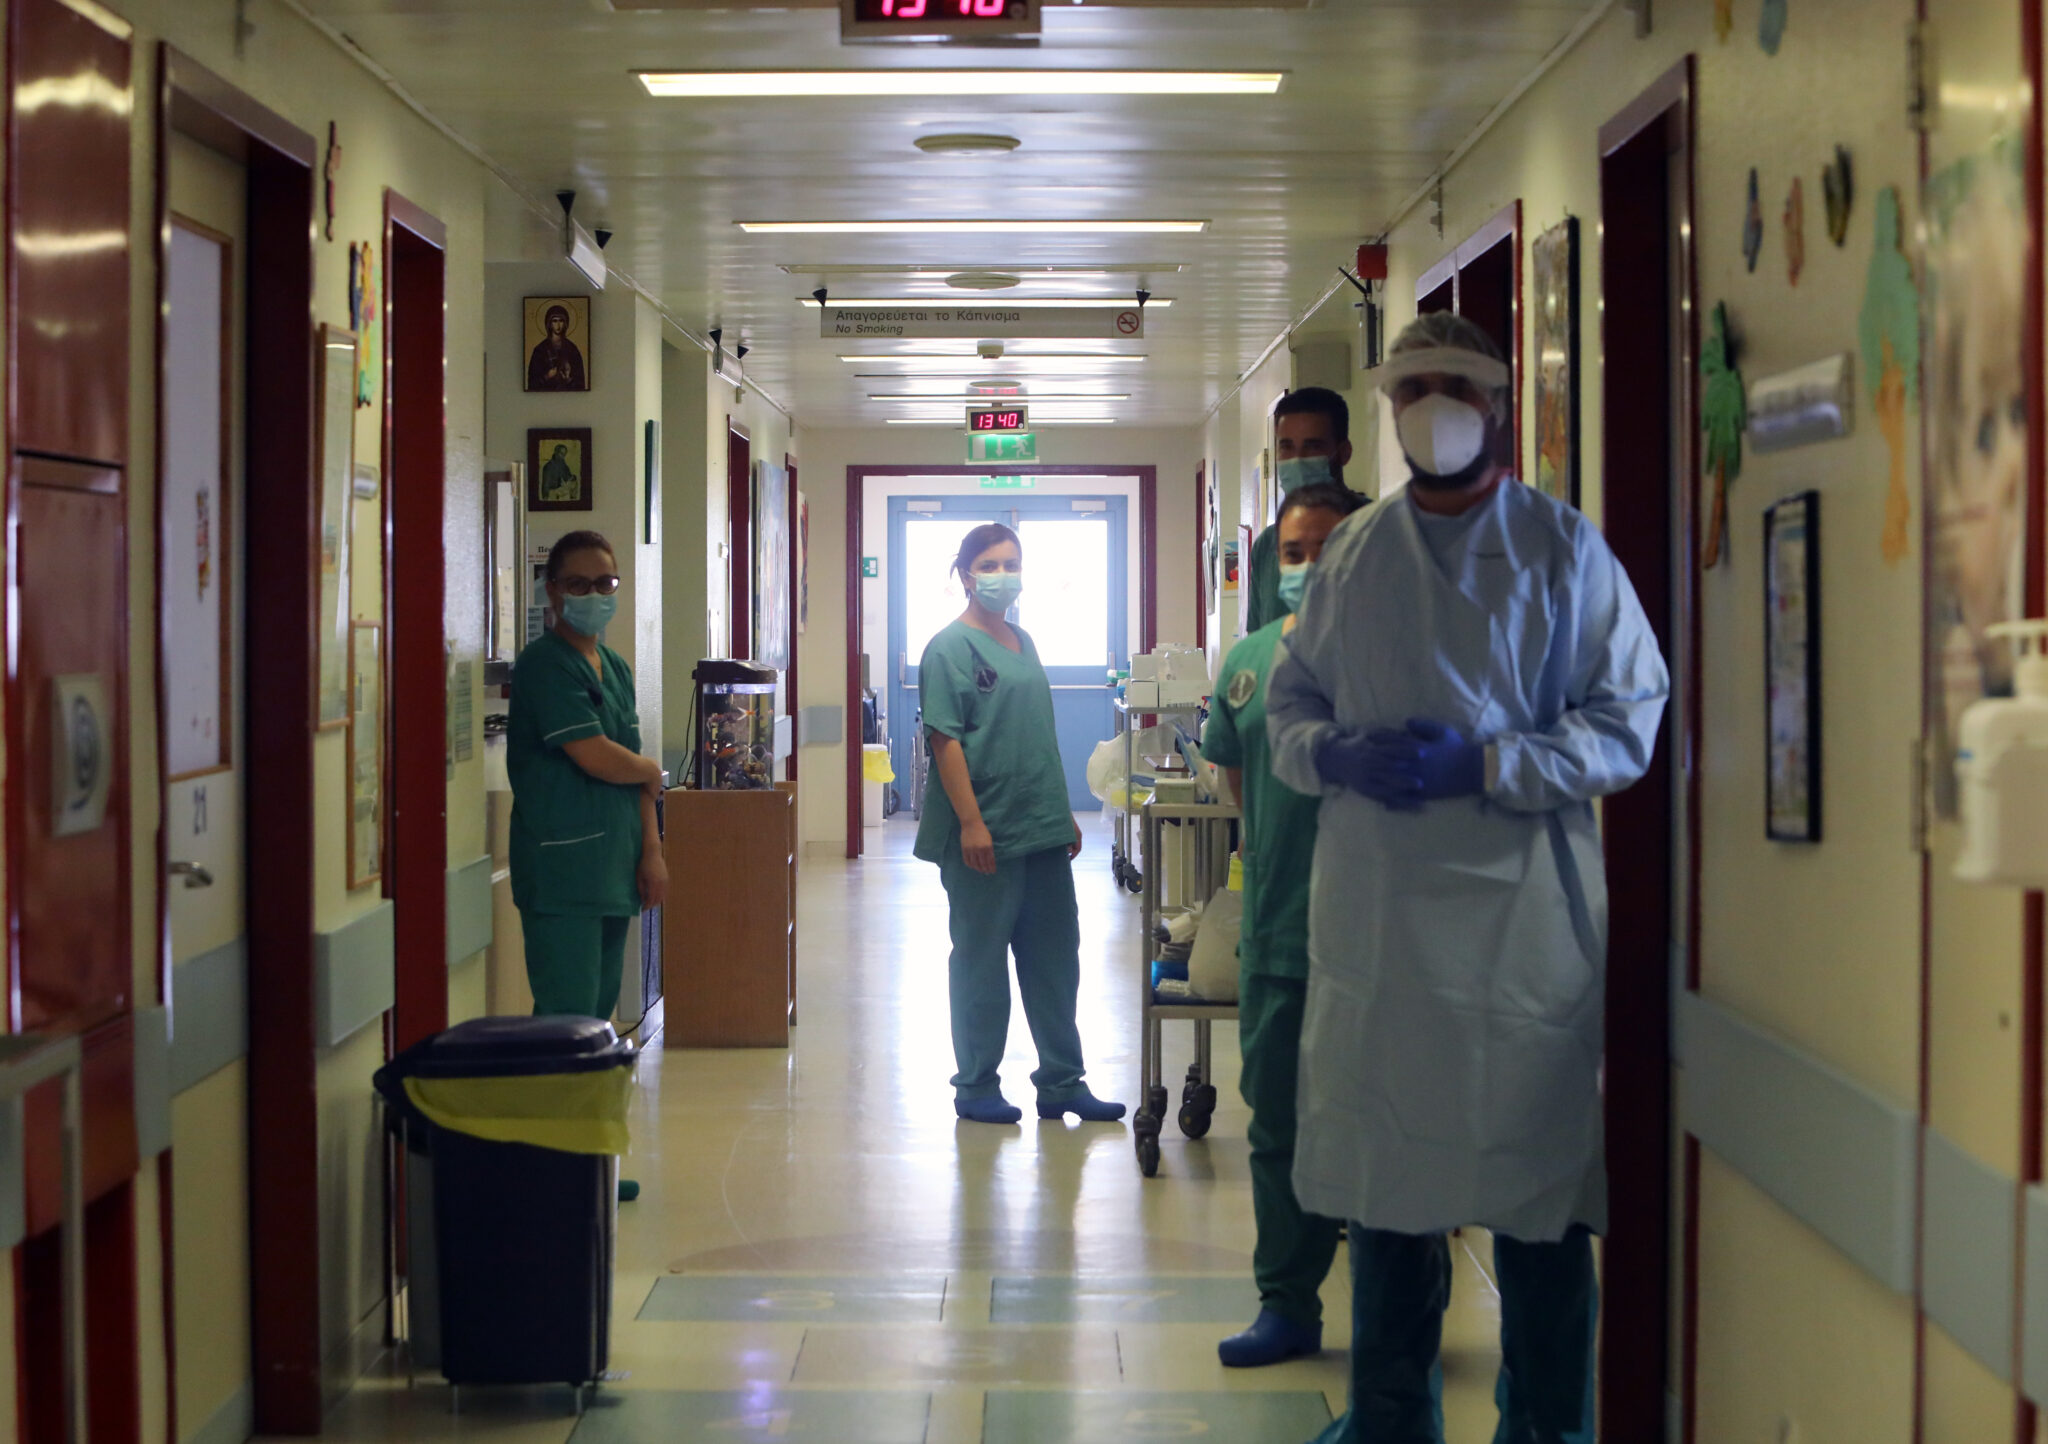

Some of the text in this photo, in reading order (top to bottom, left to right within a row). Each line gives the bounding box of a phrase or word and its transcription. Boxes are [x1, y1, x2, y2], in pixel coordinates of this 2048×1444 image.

[835, 310, 1020, 324] Απαγορεύεται το Κάπνισμα
[835, 324, 904, 335] No Smoking
